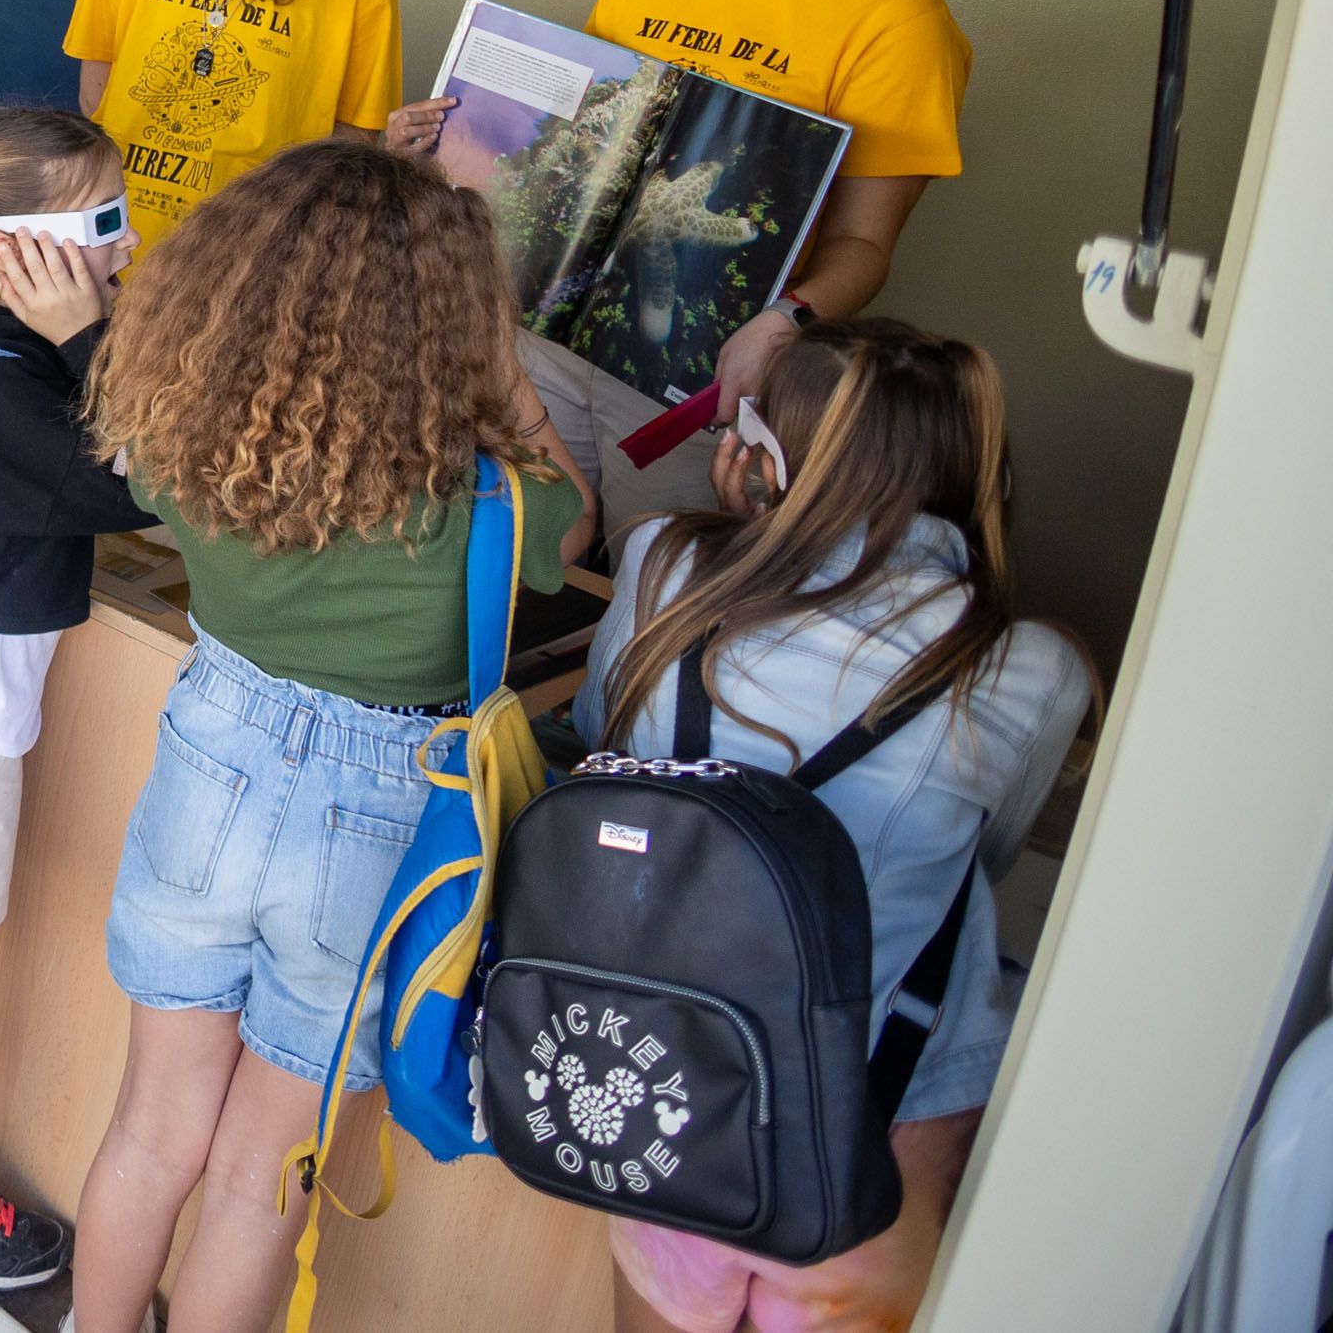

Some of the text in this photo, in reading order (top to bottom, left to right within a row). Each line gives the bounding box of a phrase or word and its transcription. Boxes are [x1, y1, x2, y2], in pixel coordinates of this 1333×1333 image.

[239, 3, 266, 28] DE
[268, 10, 292, 38] LA
[635, 17, 791, 75] XII FERIA DE LA
[142, 125, 213, 153] CIENCIA
[123, 142, 214, 193] JEREZ 2024
[1085, 260, 1117, 294] 19
[531, 1003, 688, 1102] MICKEY
[525, 1106, 681, 1193] MOUSE
